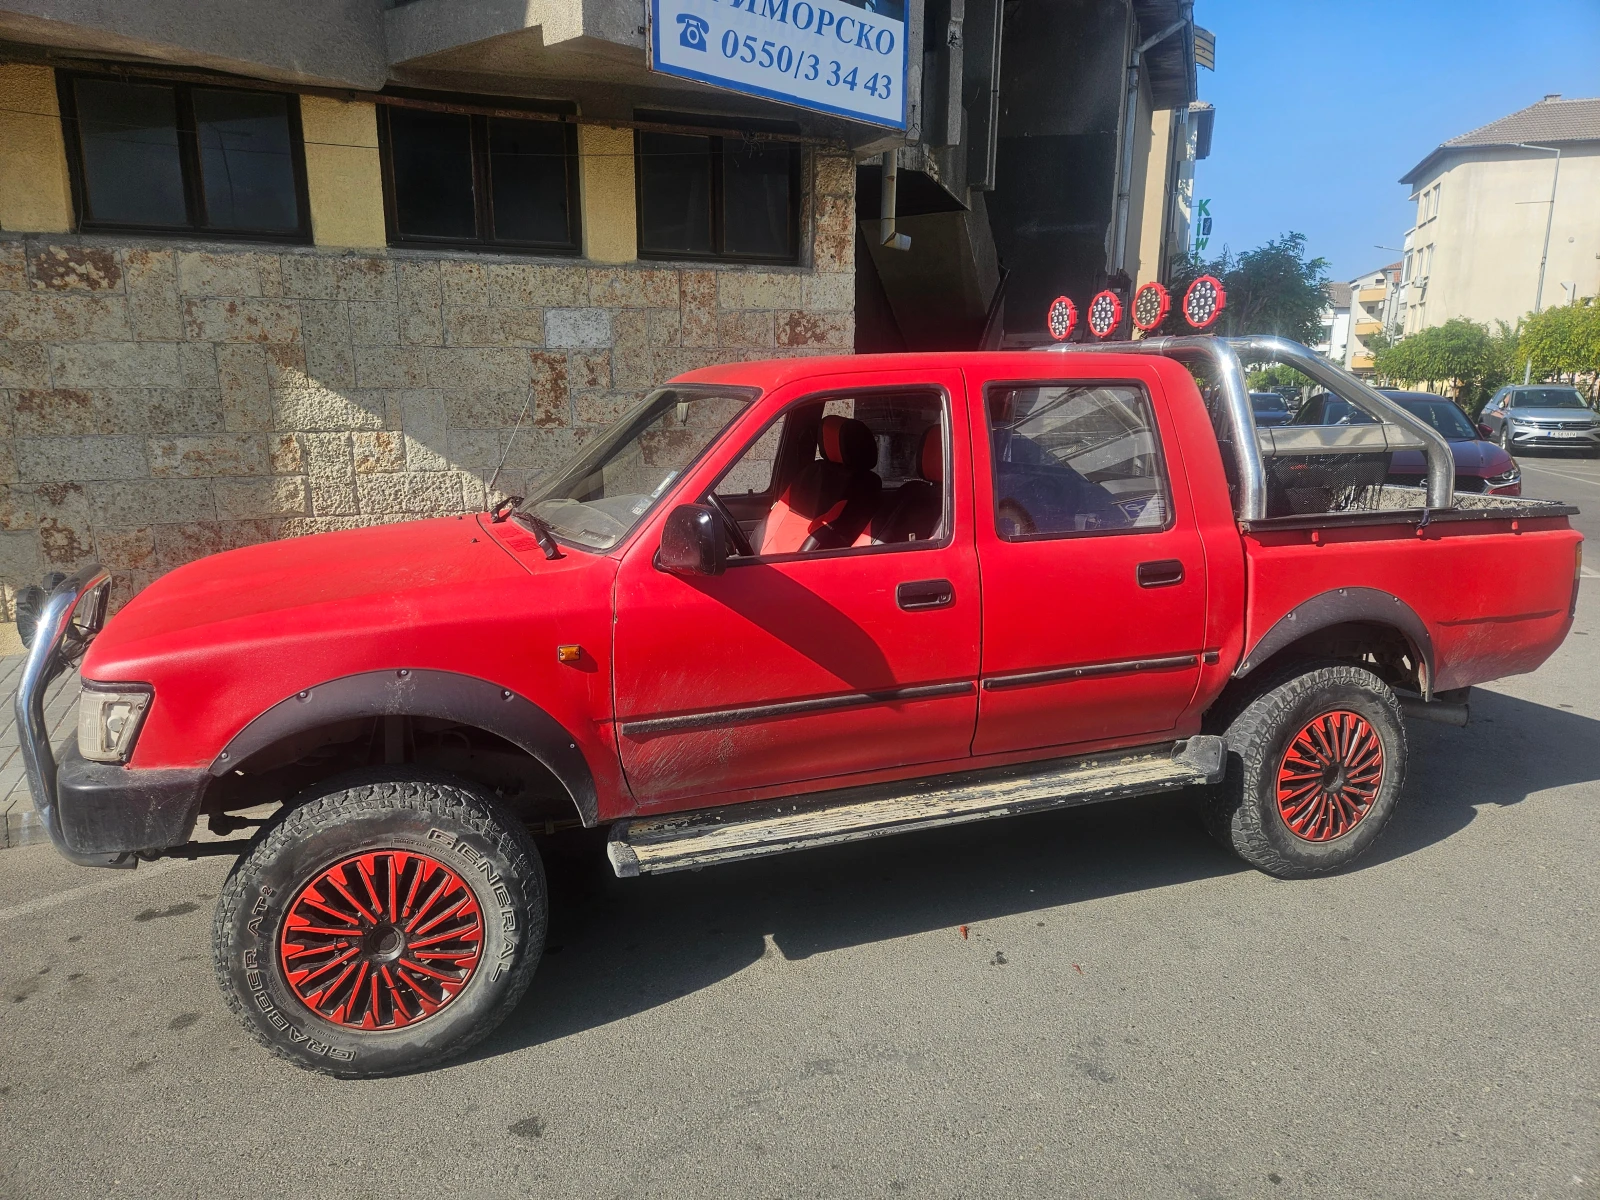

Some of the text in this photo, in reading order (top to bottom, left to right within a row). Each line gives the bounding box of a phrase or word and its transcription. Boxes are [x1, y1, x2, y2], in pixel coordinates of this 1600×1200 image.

[721, 29, 892, 100] 0550/3 34 43
[427, 828, 517, 983] GENERAL
[245, 949, 356, 1062] GRABBER
